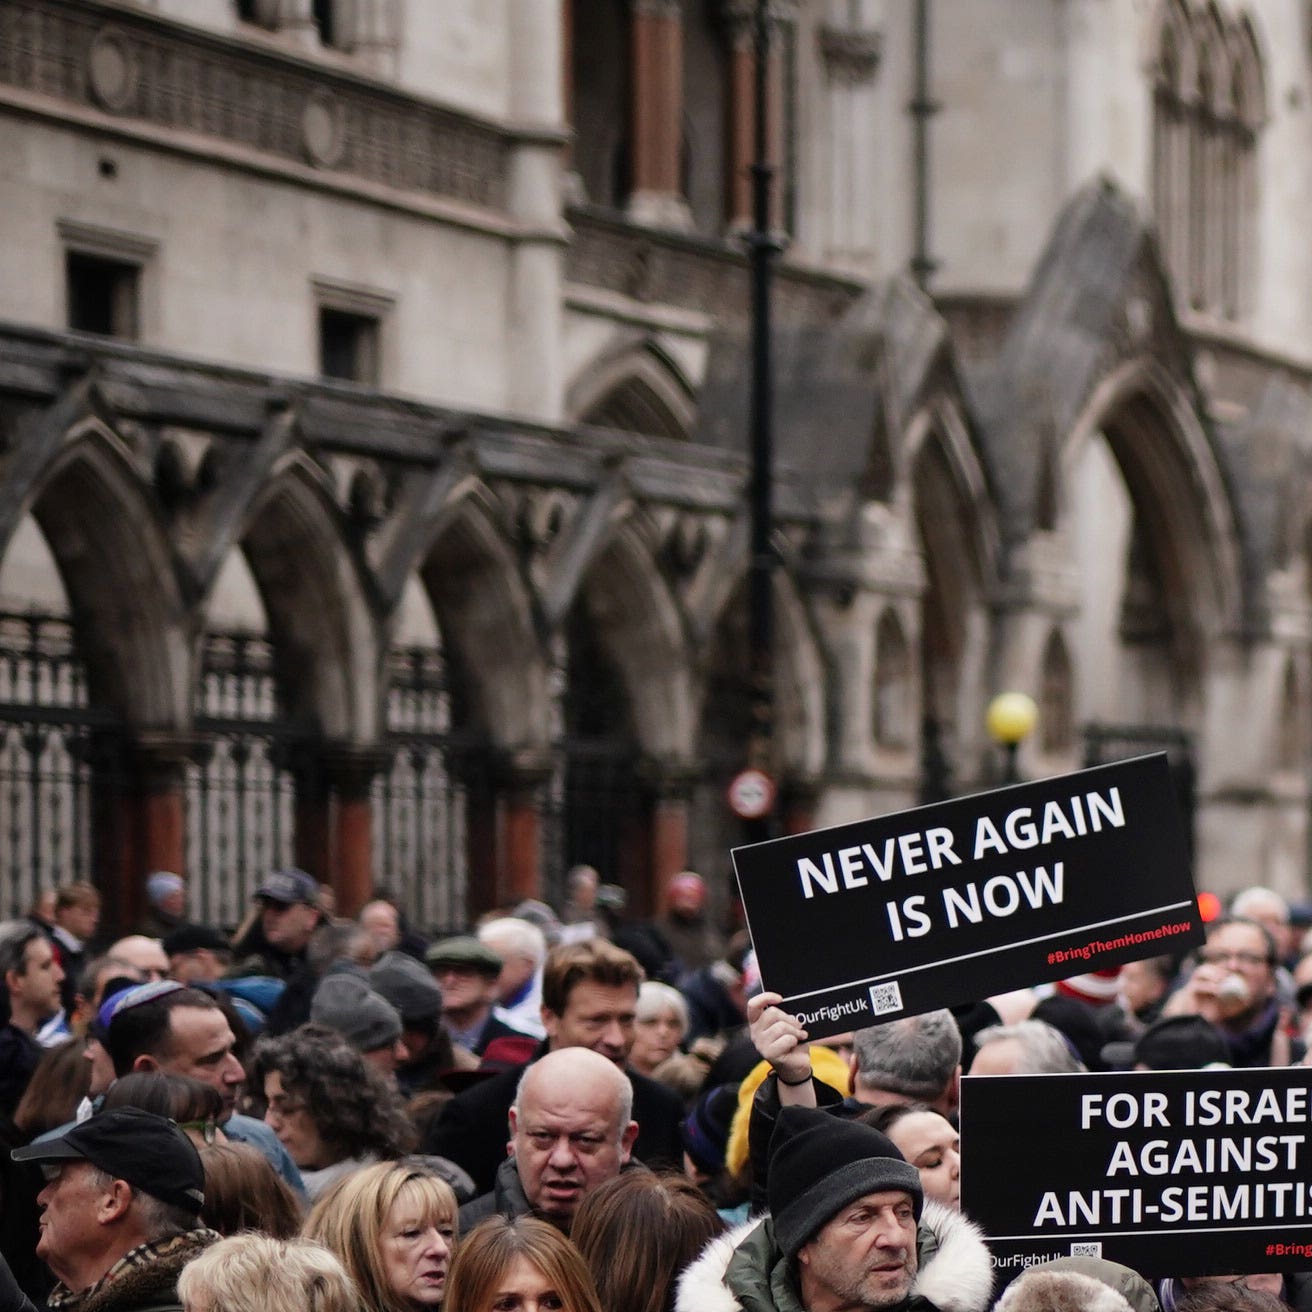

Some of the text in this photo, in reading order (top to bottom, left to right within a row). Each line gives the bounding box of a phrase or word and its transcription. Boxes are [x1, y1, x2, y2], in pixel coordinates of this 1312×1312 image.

[797, 787, 1125, 898] NEVER AGAIN
[887, 862, 1064, 941] IS NOW
[1047, 923, 1191, 965] #BringThemHomeNow
[795, 999, 868, 1026] OurFightUk
[1081, 1093, 1171, 1129] FOR
[1106, 1135, 1305, 1176] AGAINST
